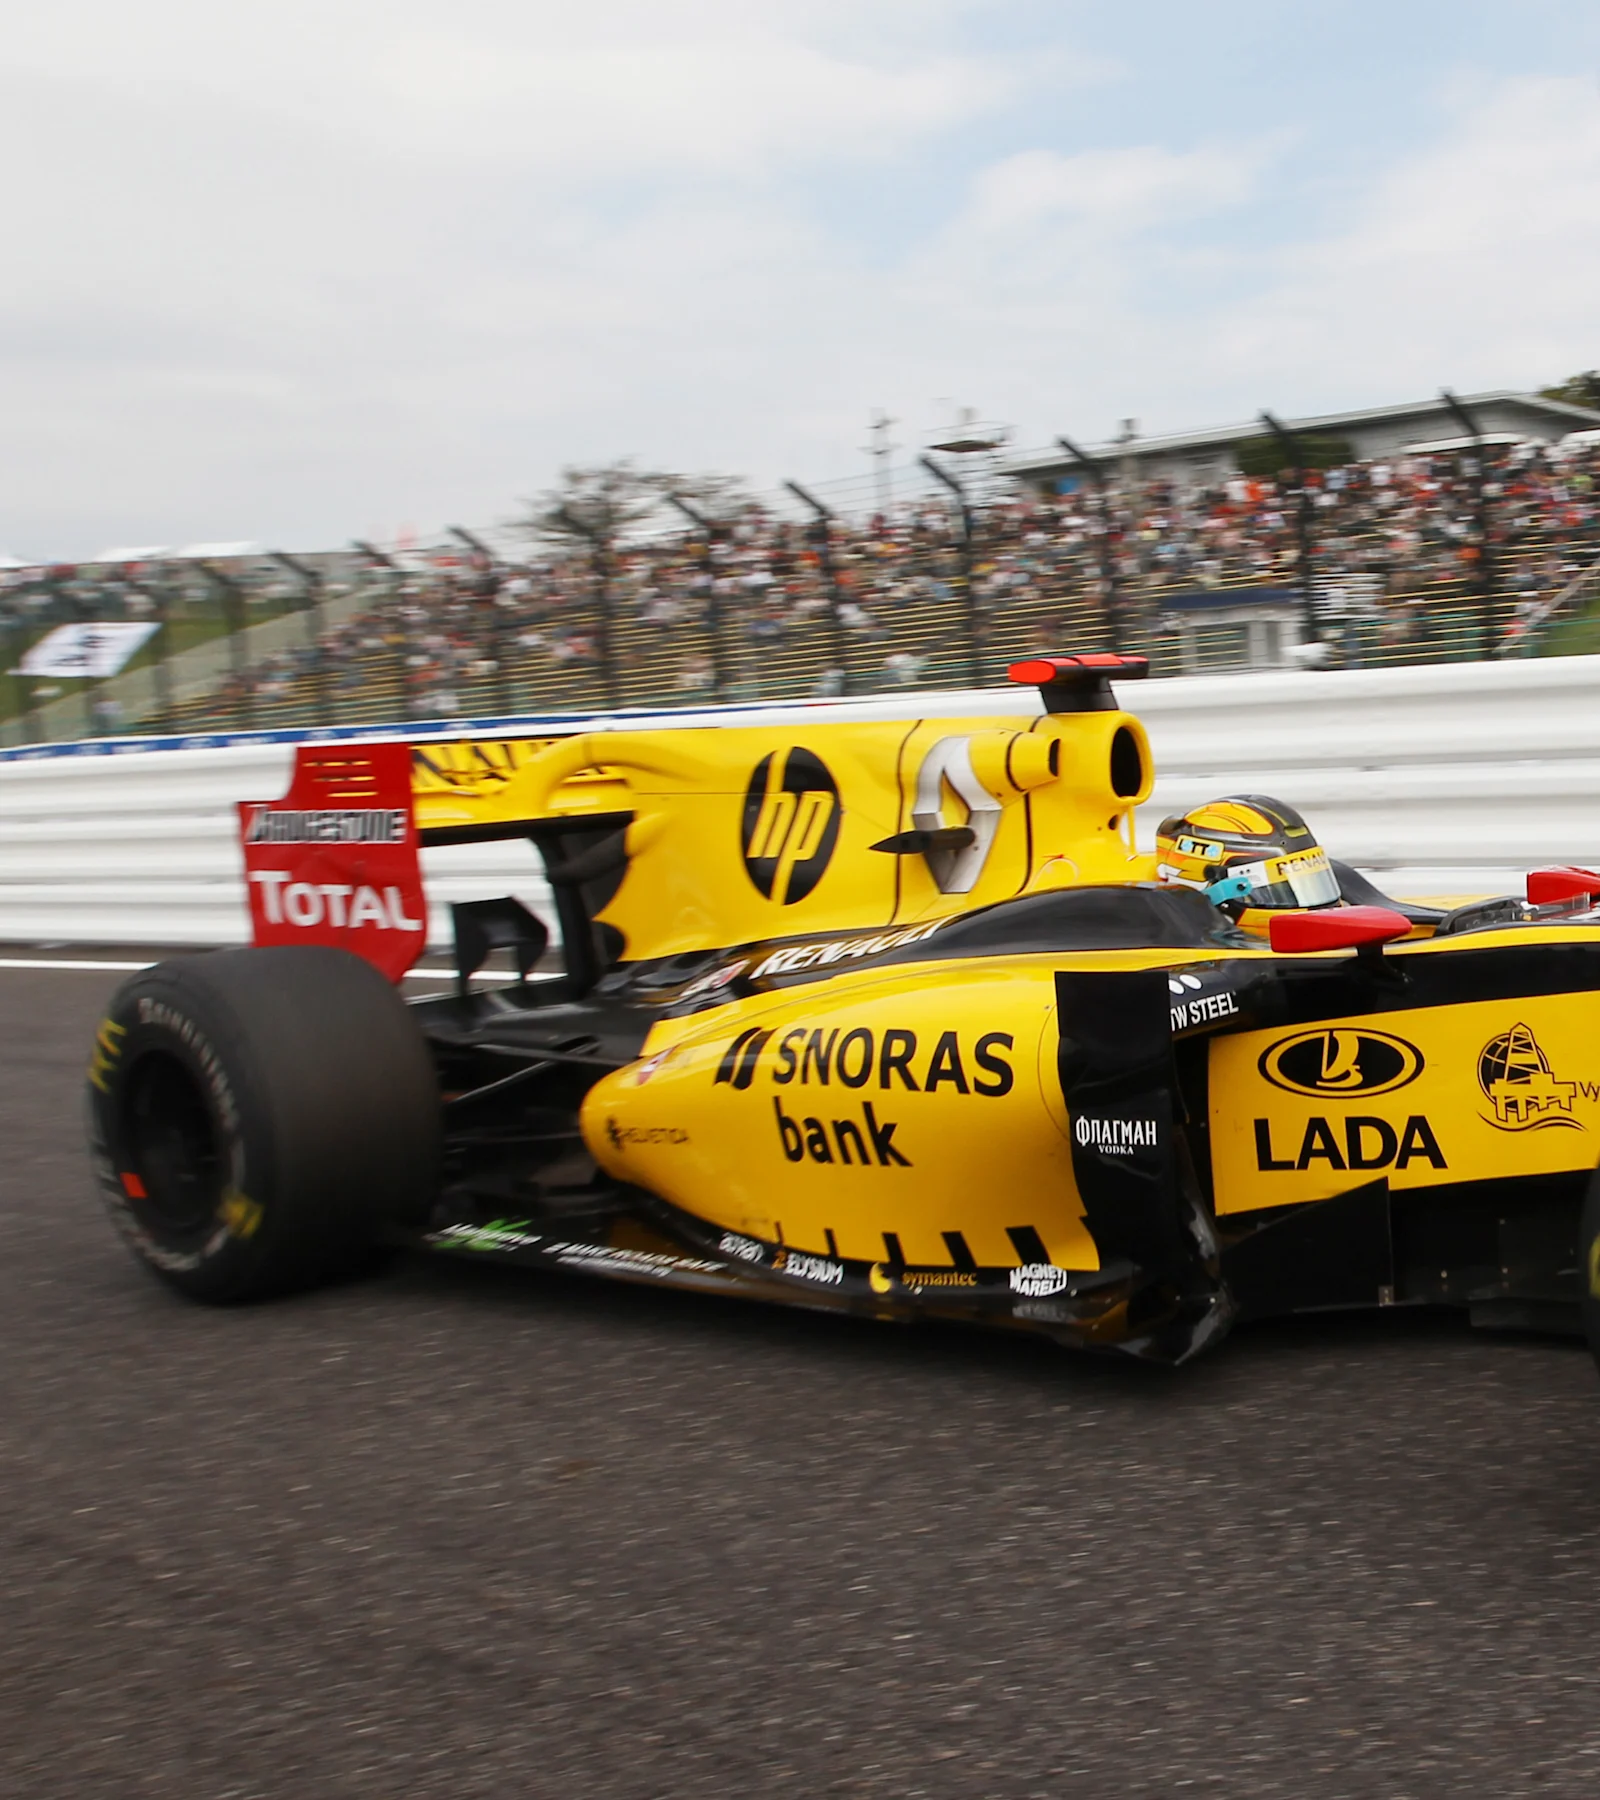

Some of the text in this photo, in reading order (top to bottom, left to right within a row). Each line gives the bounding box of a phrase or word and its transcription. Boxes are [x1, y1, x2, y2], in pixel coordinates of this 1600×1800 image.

[249, 870, 422, 931] TOTAL
[749, 913, 957, 979] RENAULT
[1188, 992, 1239, 1024] STEEL
[772, 1027, 1015, 1097] SNORAS
[773, 1096, 913, 1167] bank
[1098, 1145, 1134, 1155] VODKA
[1254, 1116, 1448, 1171] LADA
[902, 1270, 977, 1287] symantec
